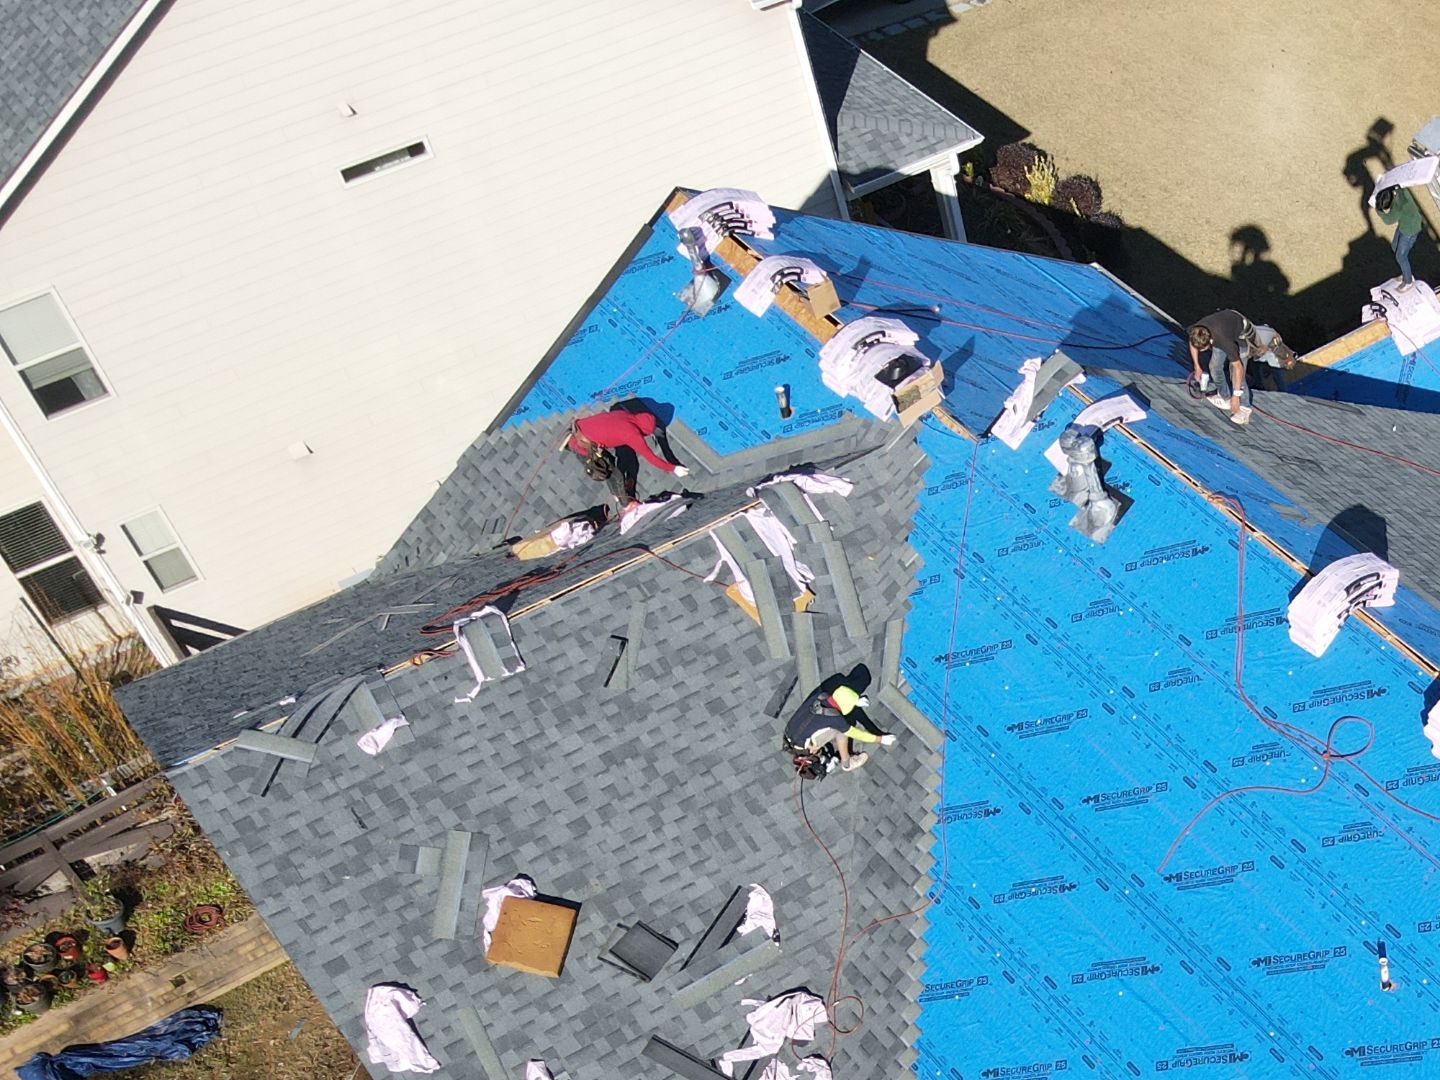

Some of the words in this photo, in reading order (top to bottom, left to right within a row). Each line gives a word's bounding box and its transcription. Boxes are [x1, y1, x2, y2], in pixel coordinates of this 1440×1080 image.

[1292, 702, 1304, 712] 25
[1242, 861, 1253, 870] 25
[1333, 946, 1346, 956] 25
[1071, 974, 1082, 983] 25
[1055, 1060, 1066, 1069] 25
[1155, 1061, 1167, 1070] 25
